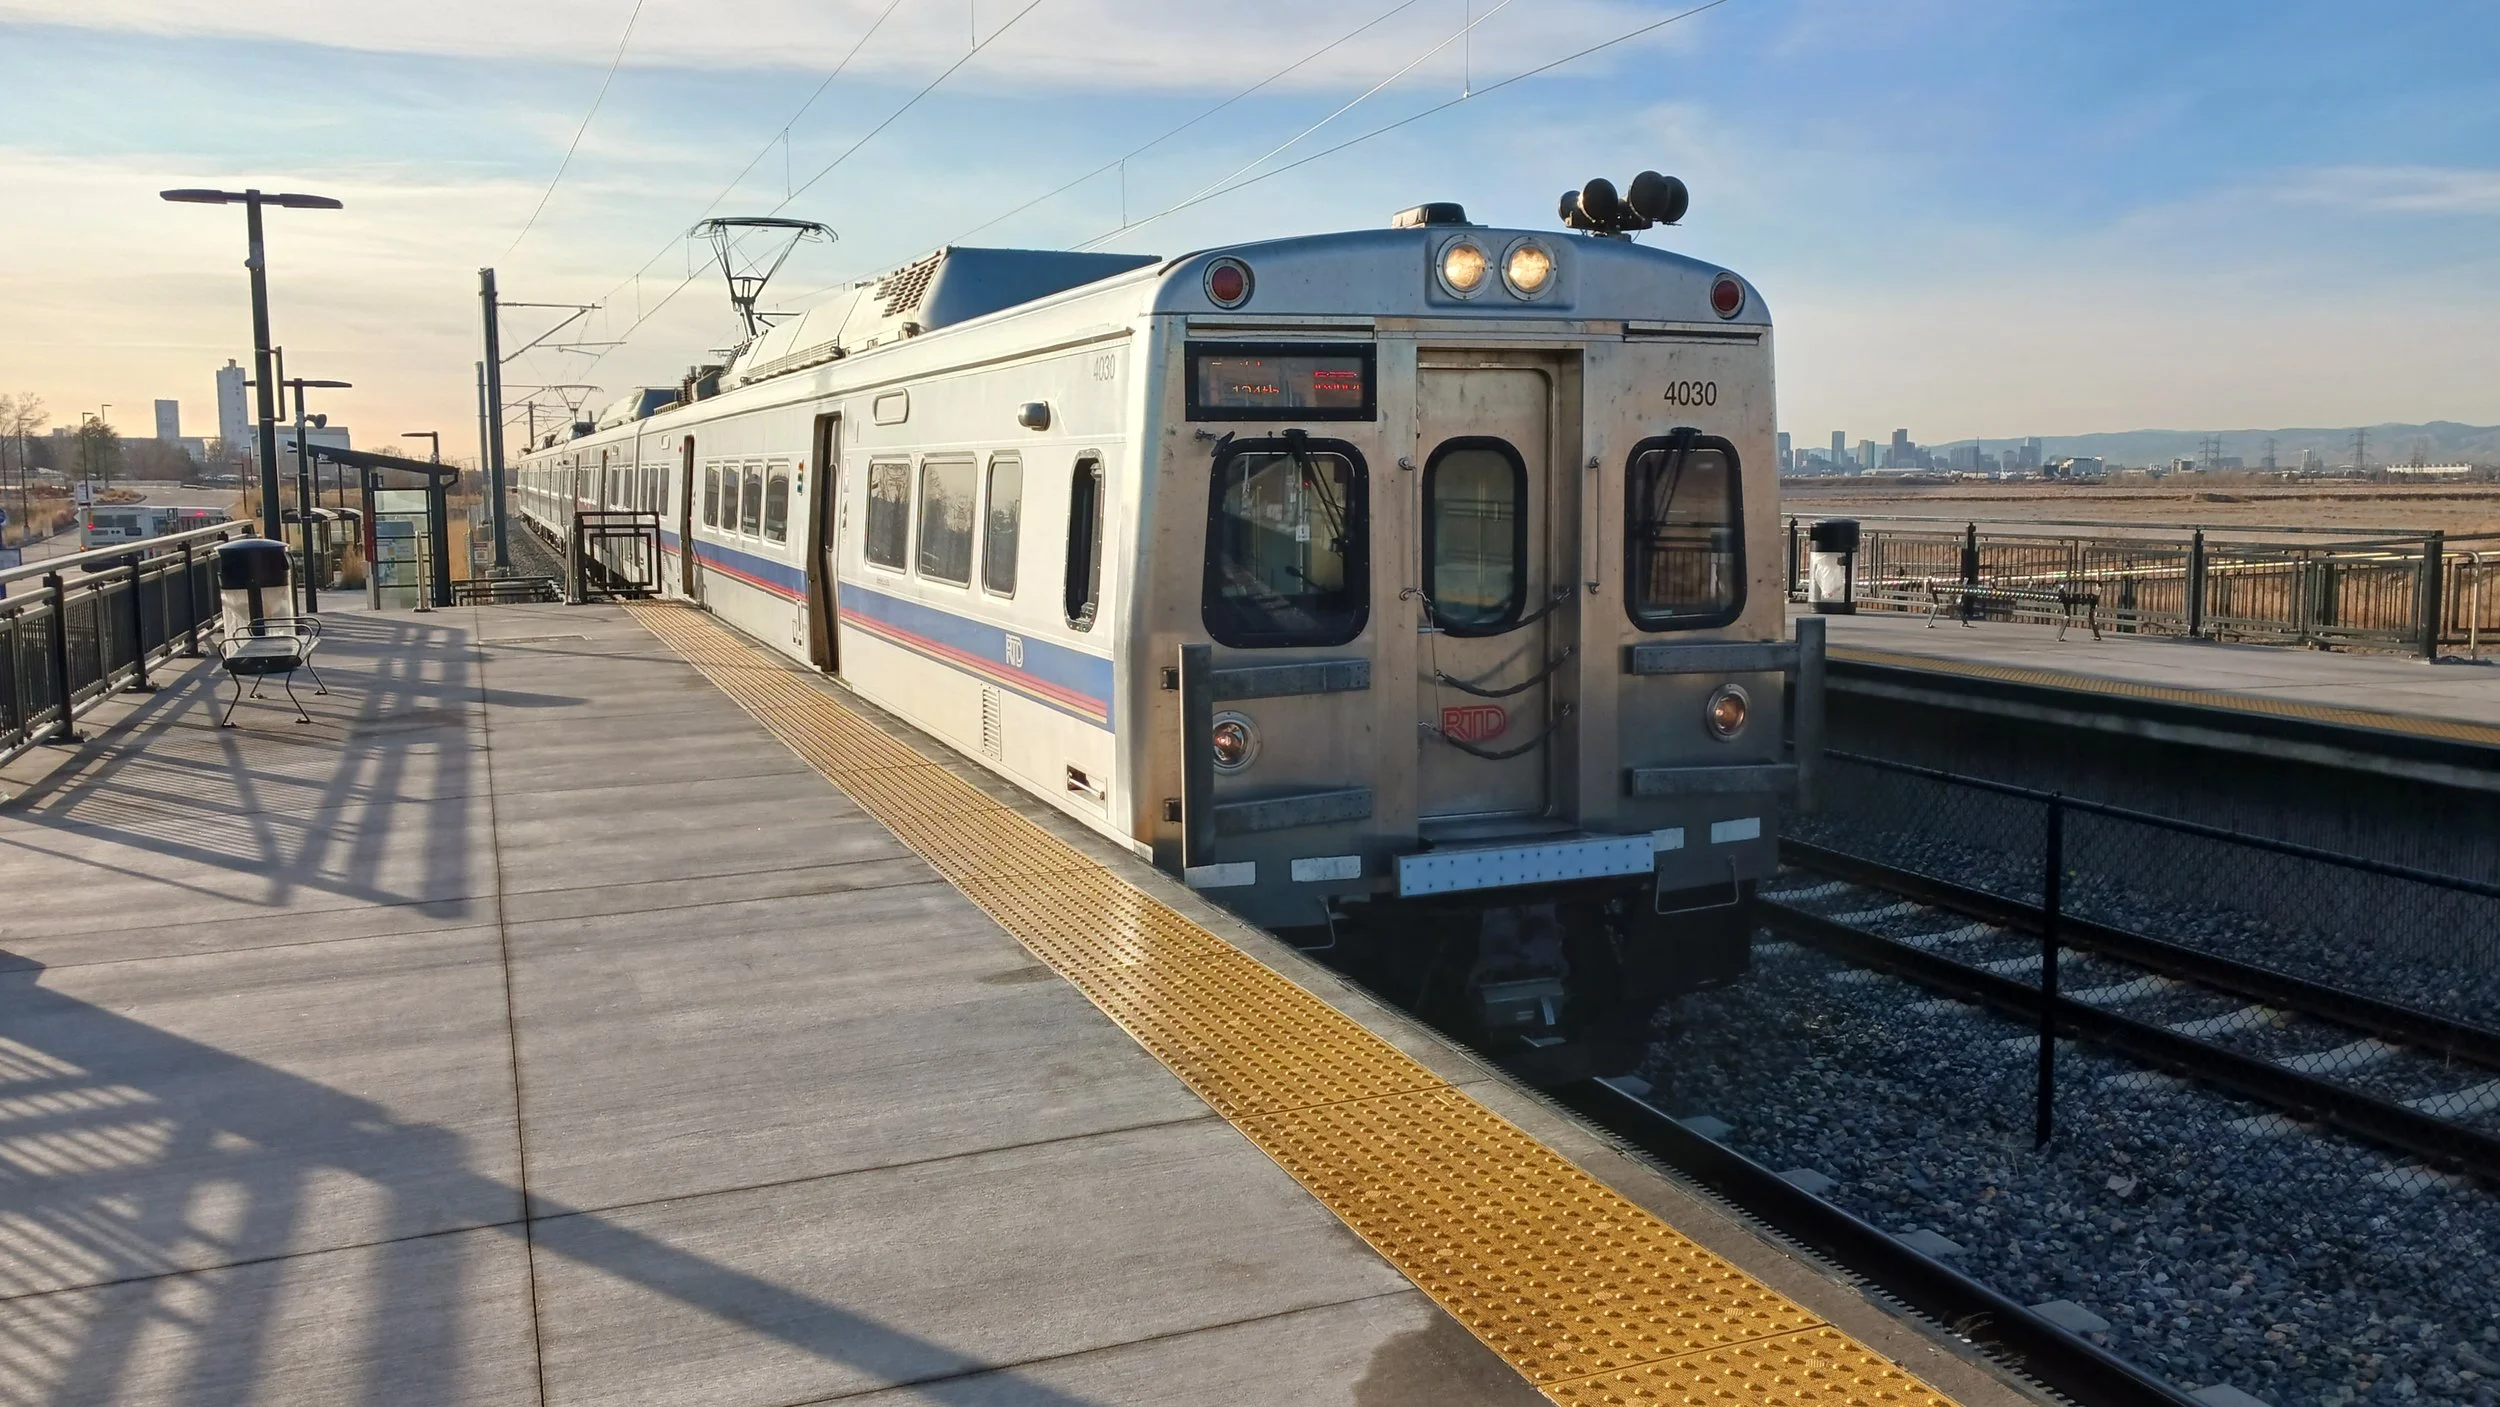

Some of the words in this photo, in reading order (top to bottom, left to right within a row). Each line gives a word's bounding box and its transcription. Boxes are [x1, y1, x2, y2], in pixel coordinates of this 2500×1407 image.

[1093, 353, 1115, 381] 4030
[1663, 380, 1717, 406] 4030
[1005, 632, 1023, 668] RTD
[1442, 704, 1505, 742] RTD
